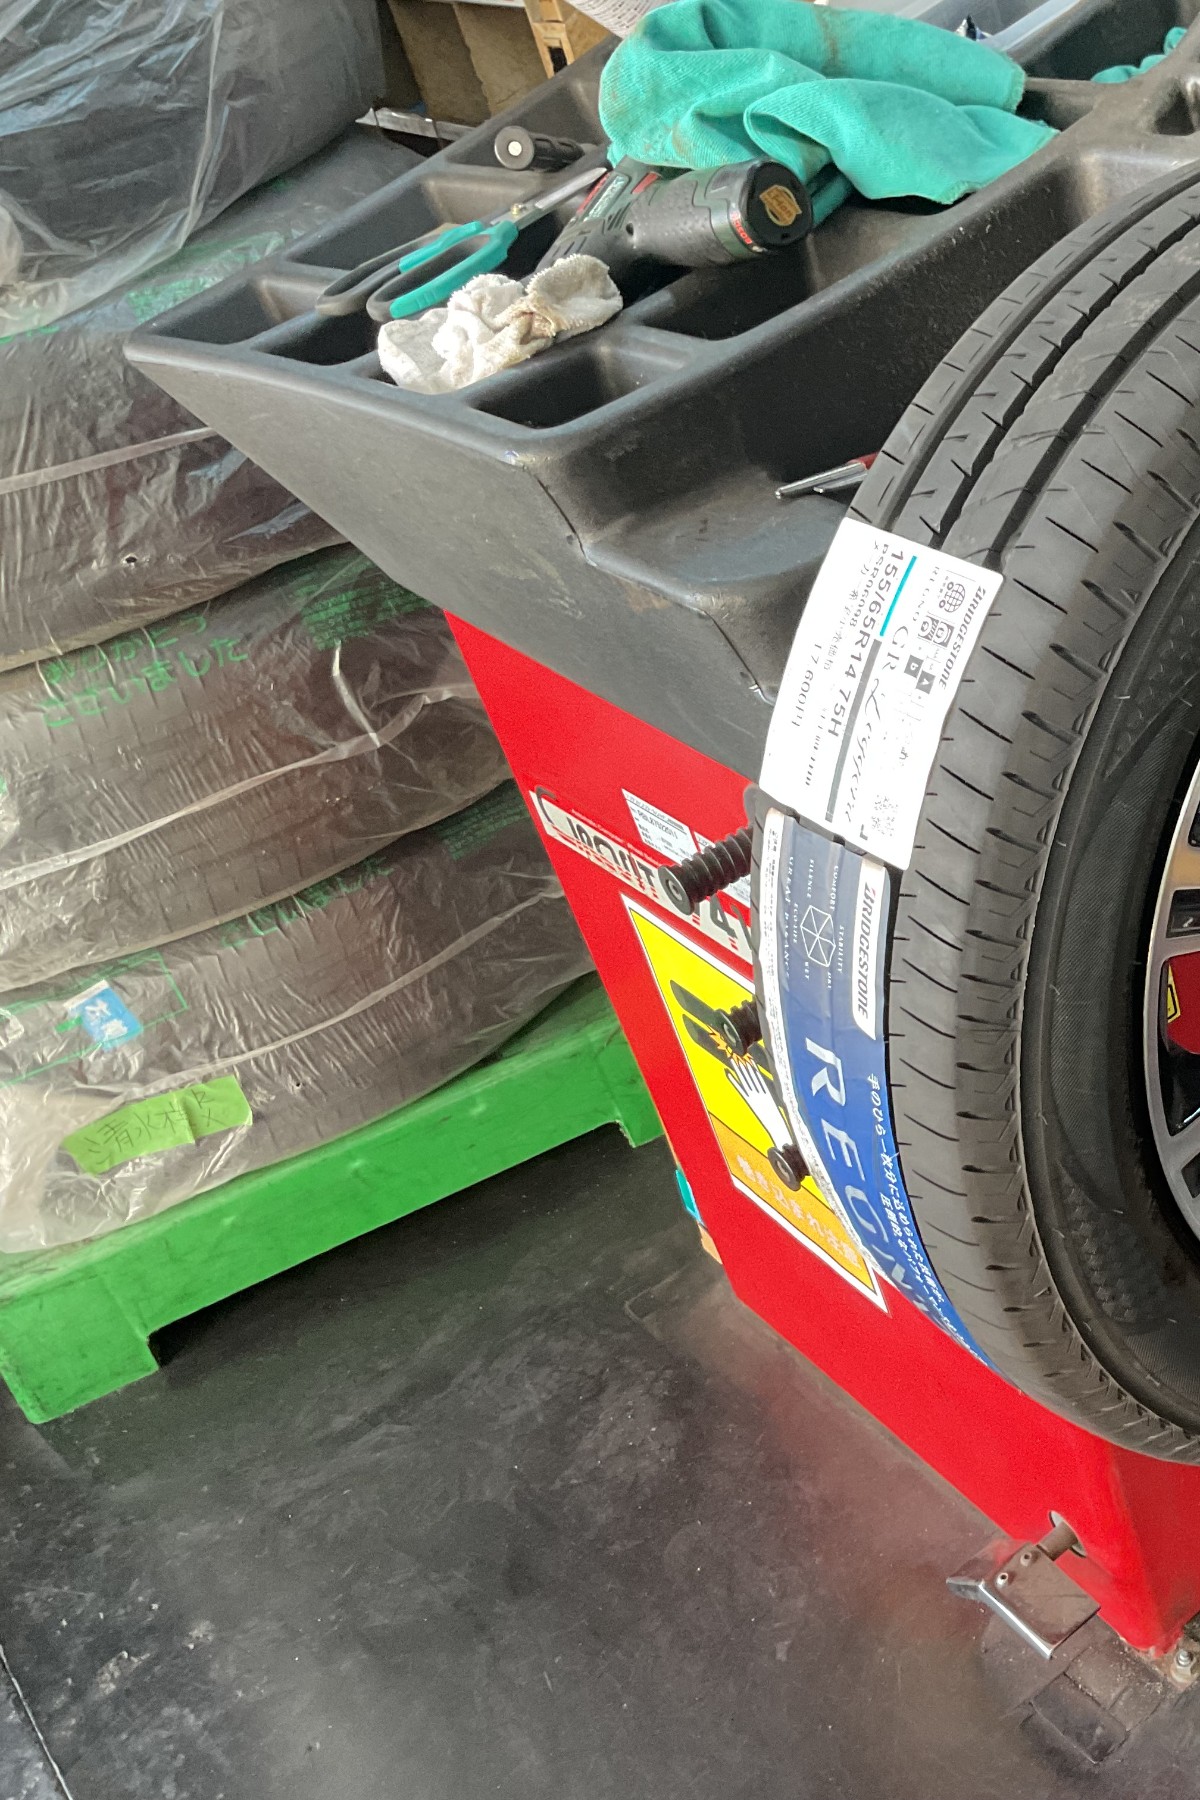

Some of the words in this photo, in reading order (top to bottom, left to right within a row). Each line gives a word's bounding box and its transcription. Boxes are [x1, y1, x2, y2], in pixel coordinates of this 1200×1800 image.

[844, 550, 905, 680] 155/65R14
[938, 584, 987, 691] BRIDGESTONE
[827, 688, 852, 738] 75H
[836, 924, 845, 974] STABILITY
[857, 881, 877, 1020] BRIDGESTONE
